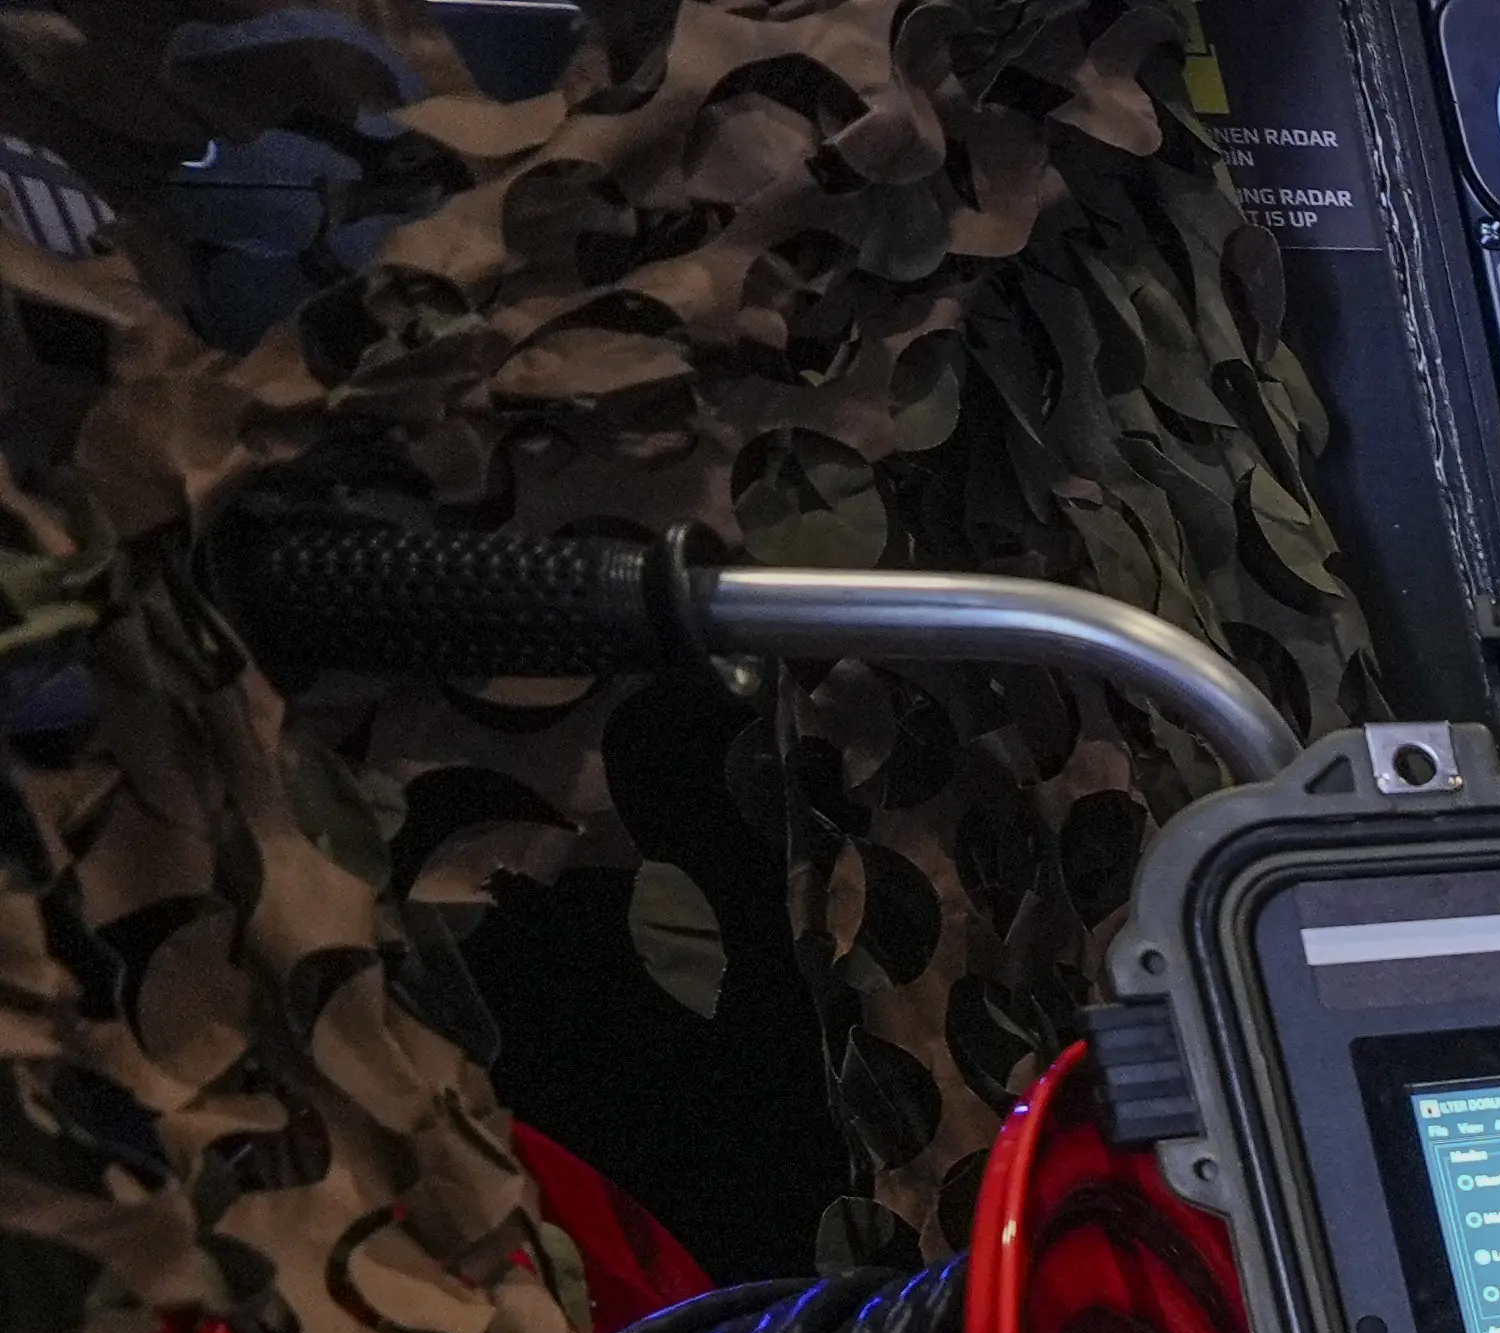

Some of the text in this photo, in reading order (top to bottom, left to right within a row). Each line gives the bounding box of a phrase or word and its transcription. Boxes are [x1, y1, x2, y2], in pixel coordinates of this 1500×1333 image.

[1264, 129, 1339, 147] RADAR
[1278, 189, 1354, 207] RADAR
[1266, 211, 1318, 227] IS UP
